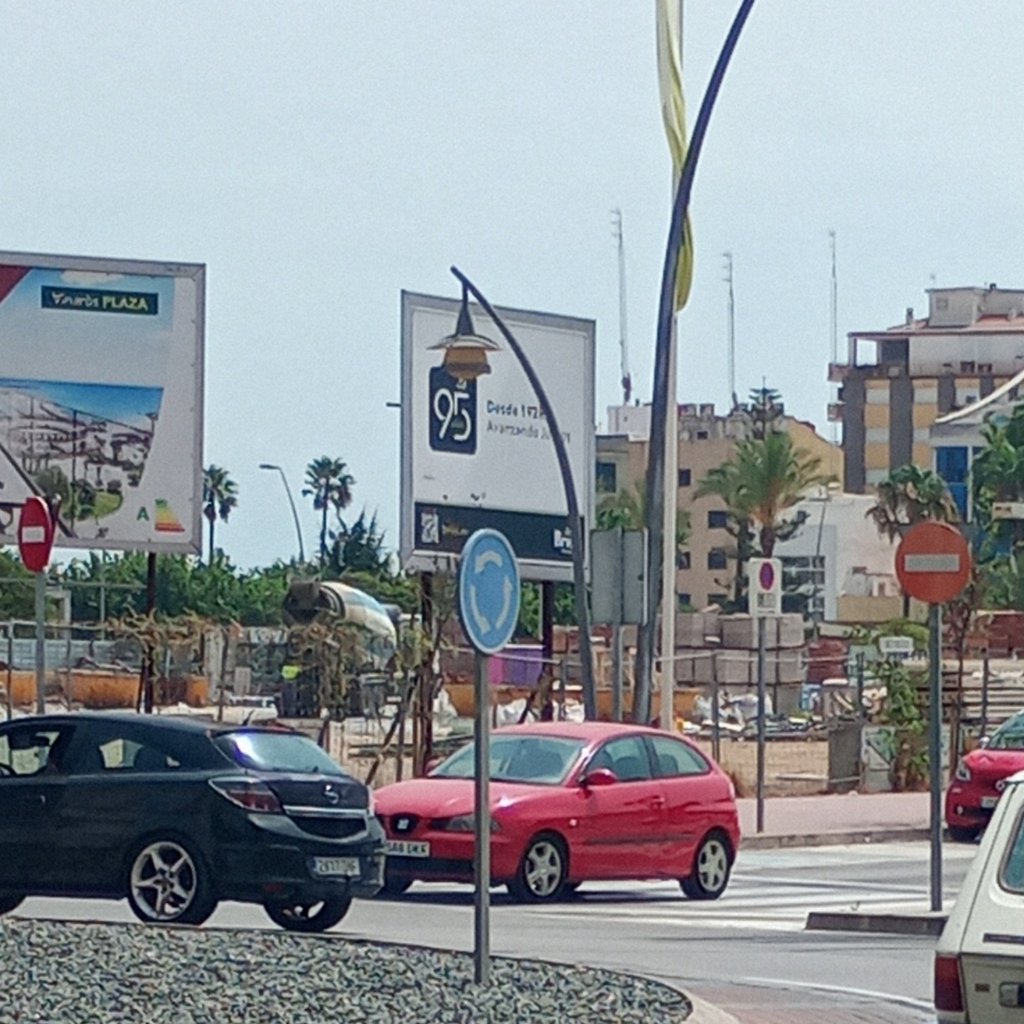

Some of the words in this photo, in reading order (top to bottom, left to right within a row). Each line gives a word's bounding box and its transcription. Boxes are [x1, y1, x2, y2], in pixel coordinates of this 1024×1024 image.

[102, 295, 149, 312] PLAZA
[433, 387, 472, 441] 95
[136, 506, 149, 521] A
